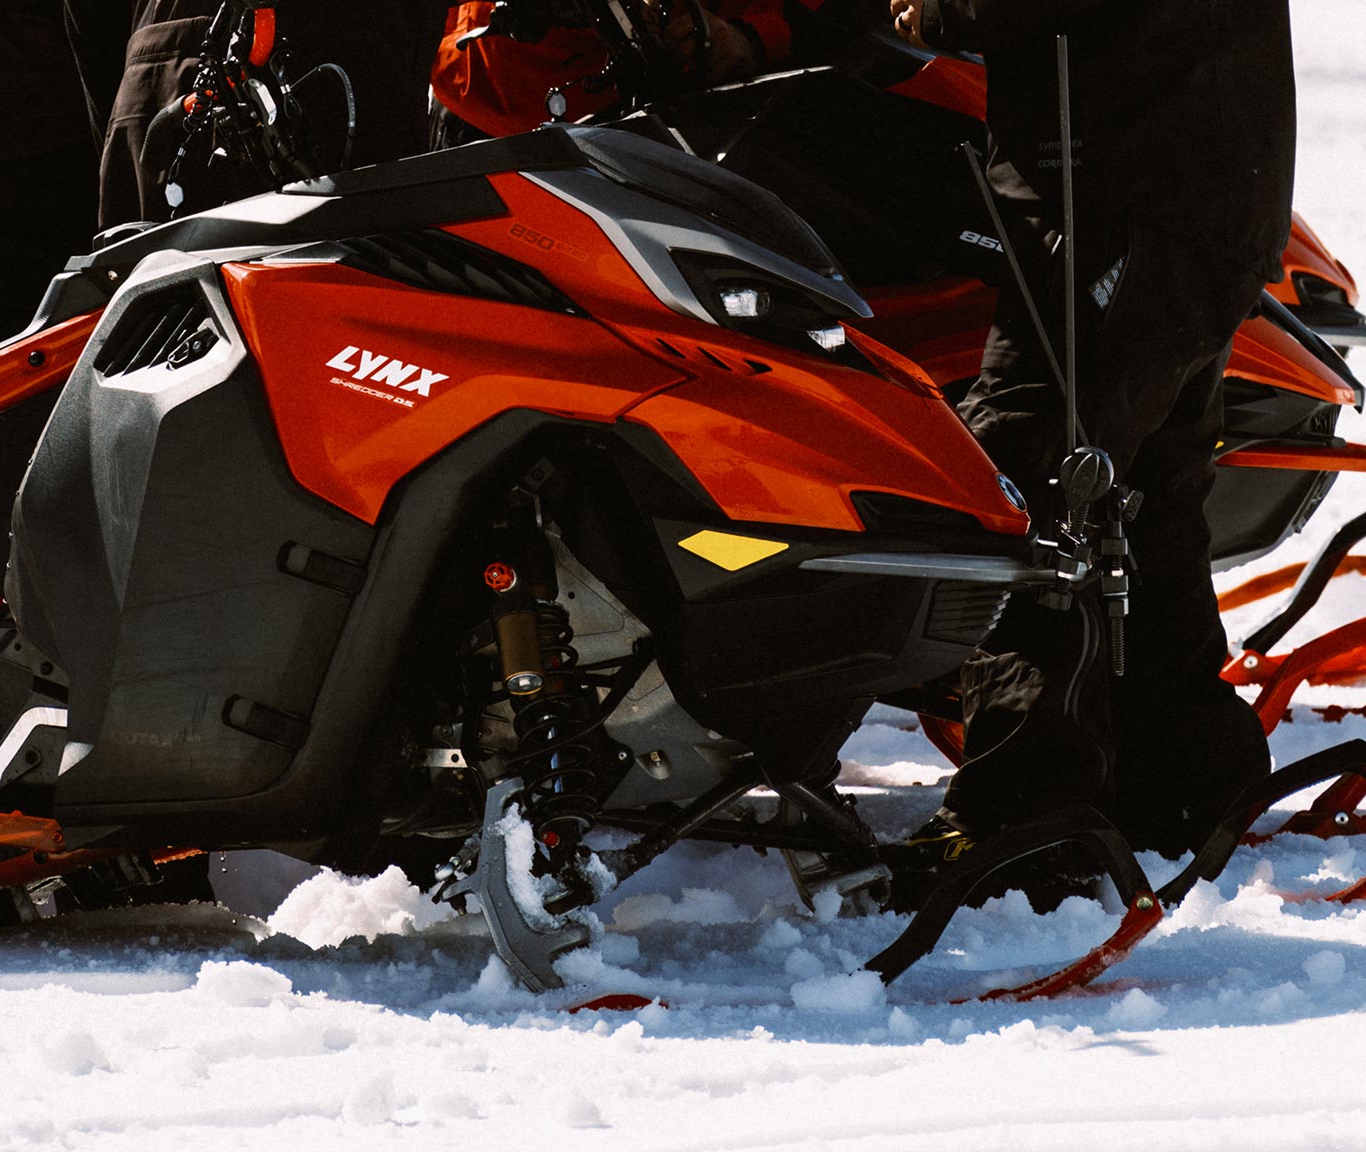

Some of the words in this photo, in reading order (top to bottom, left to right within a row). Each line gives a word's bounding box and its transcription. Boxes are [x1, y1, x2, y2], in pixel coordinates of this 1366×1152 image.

[1038, 140, 1084, 154] sympex
[1037, 158, 1084, 169] CORDRA
[509, 223, 555, 251] 850
[325, 345, 450, 398] LYNX
[330, 377, 394, 401] SHREDDER
[393, 397, 415, 408] DS
